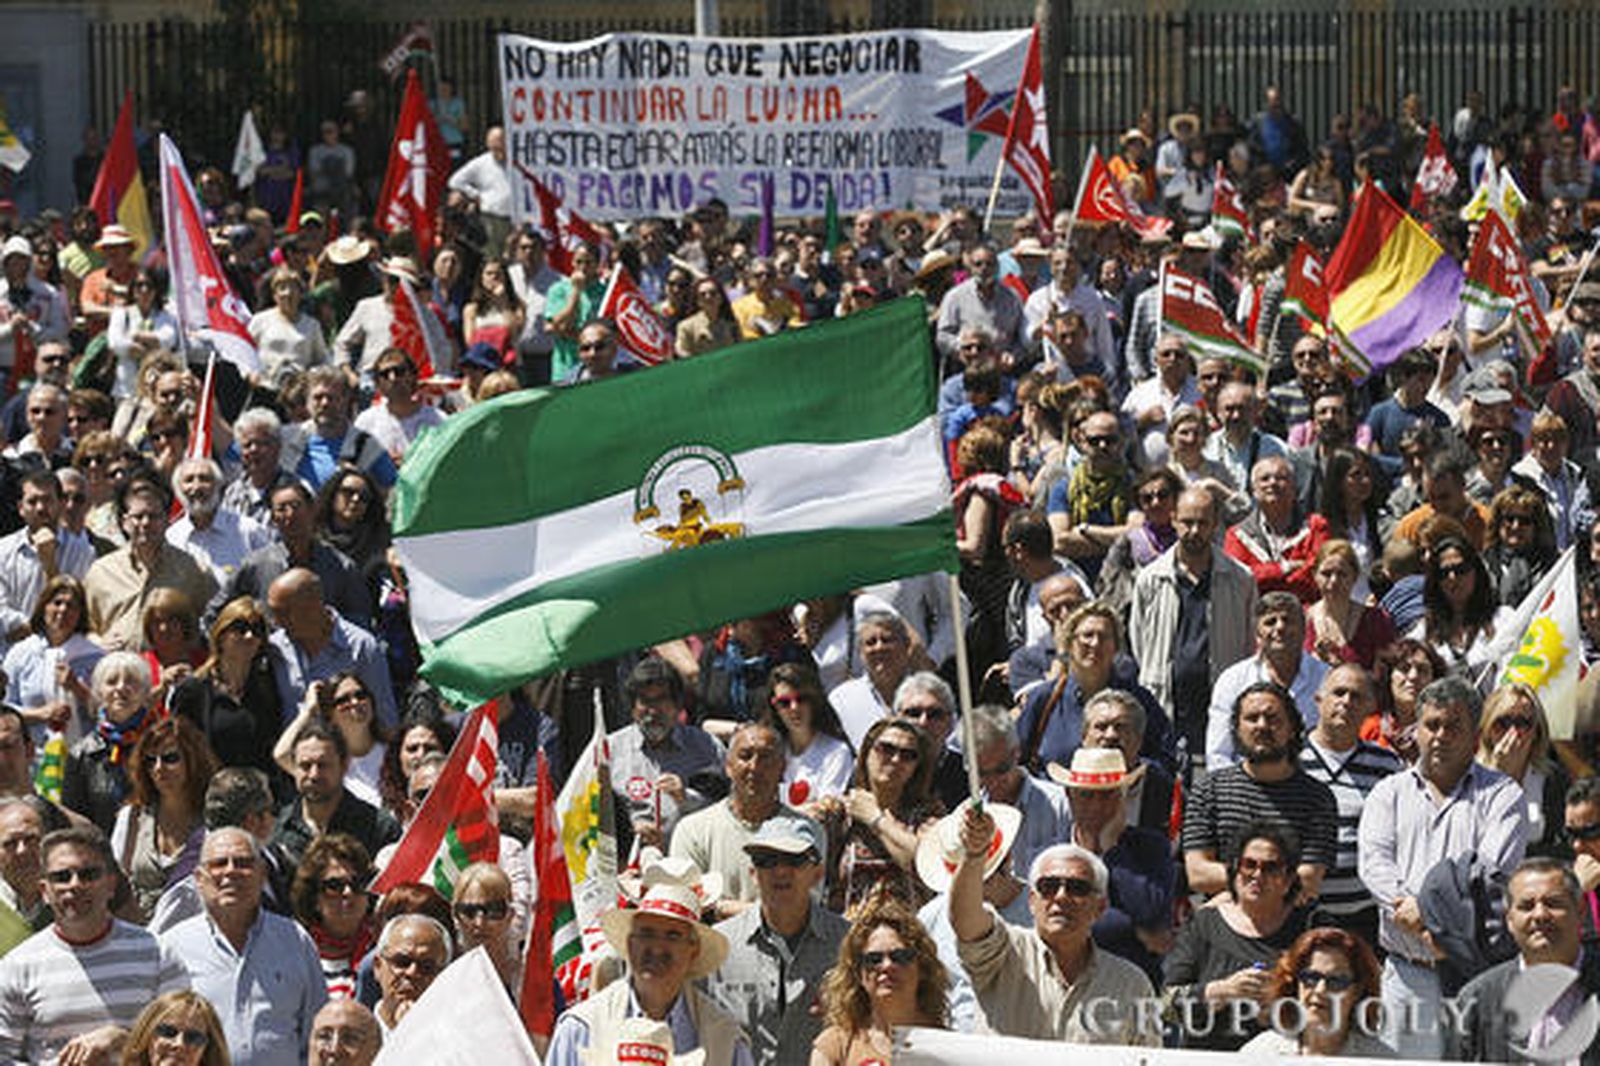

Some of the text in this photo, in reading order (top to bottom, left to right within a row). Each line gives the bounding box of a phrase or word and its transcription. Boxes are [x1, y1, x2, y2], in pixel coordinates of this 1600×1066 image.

[505, 38, 921, 79] NO HAY NADA QUE NEGOCIAR
[510, 84, 688, 123] CONTINUAR
[696, 84, 727, 122] LA
[512, 130, 602, 167] HASTA
[607, 130, 679, 170] ECHAR
[753, 131, 778, 165] LA
[783, 129, 874, 168] REFORMA
